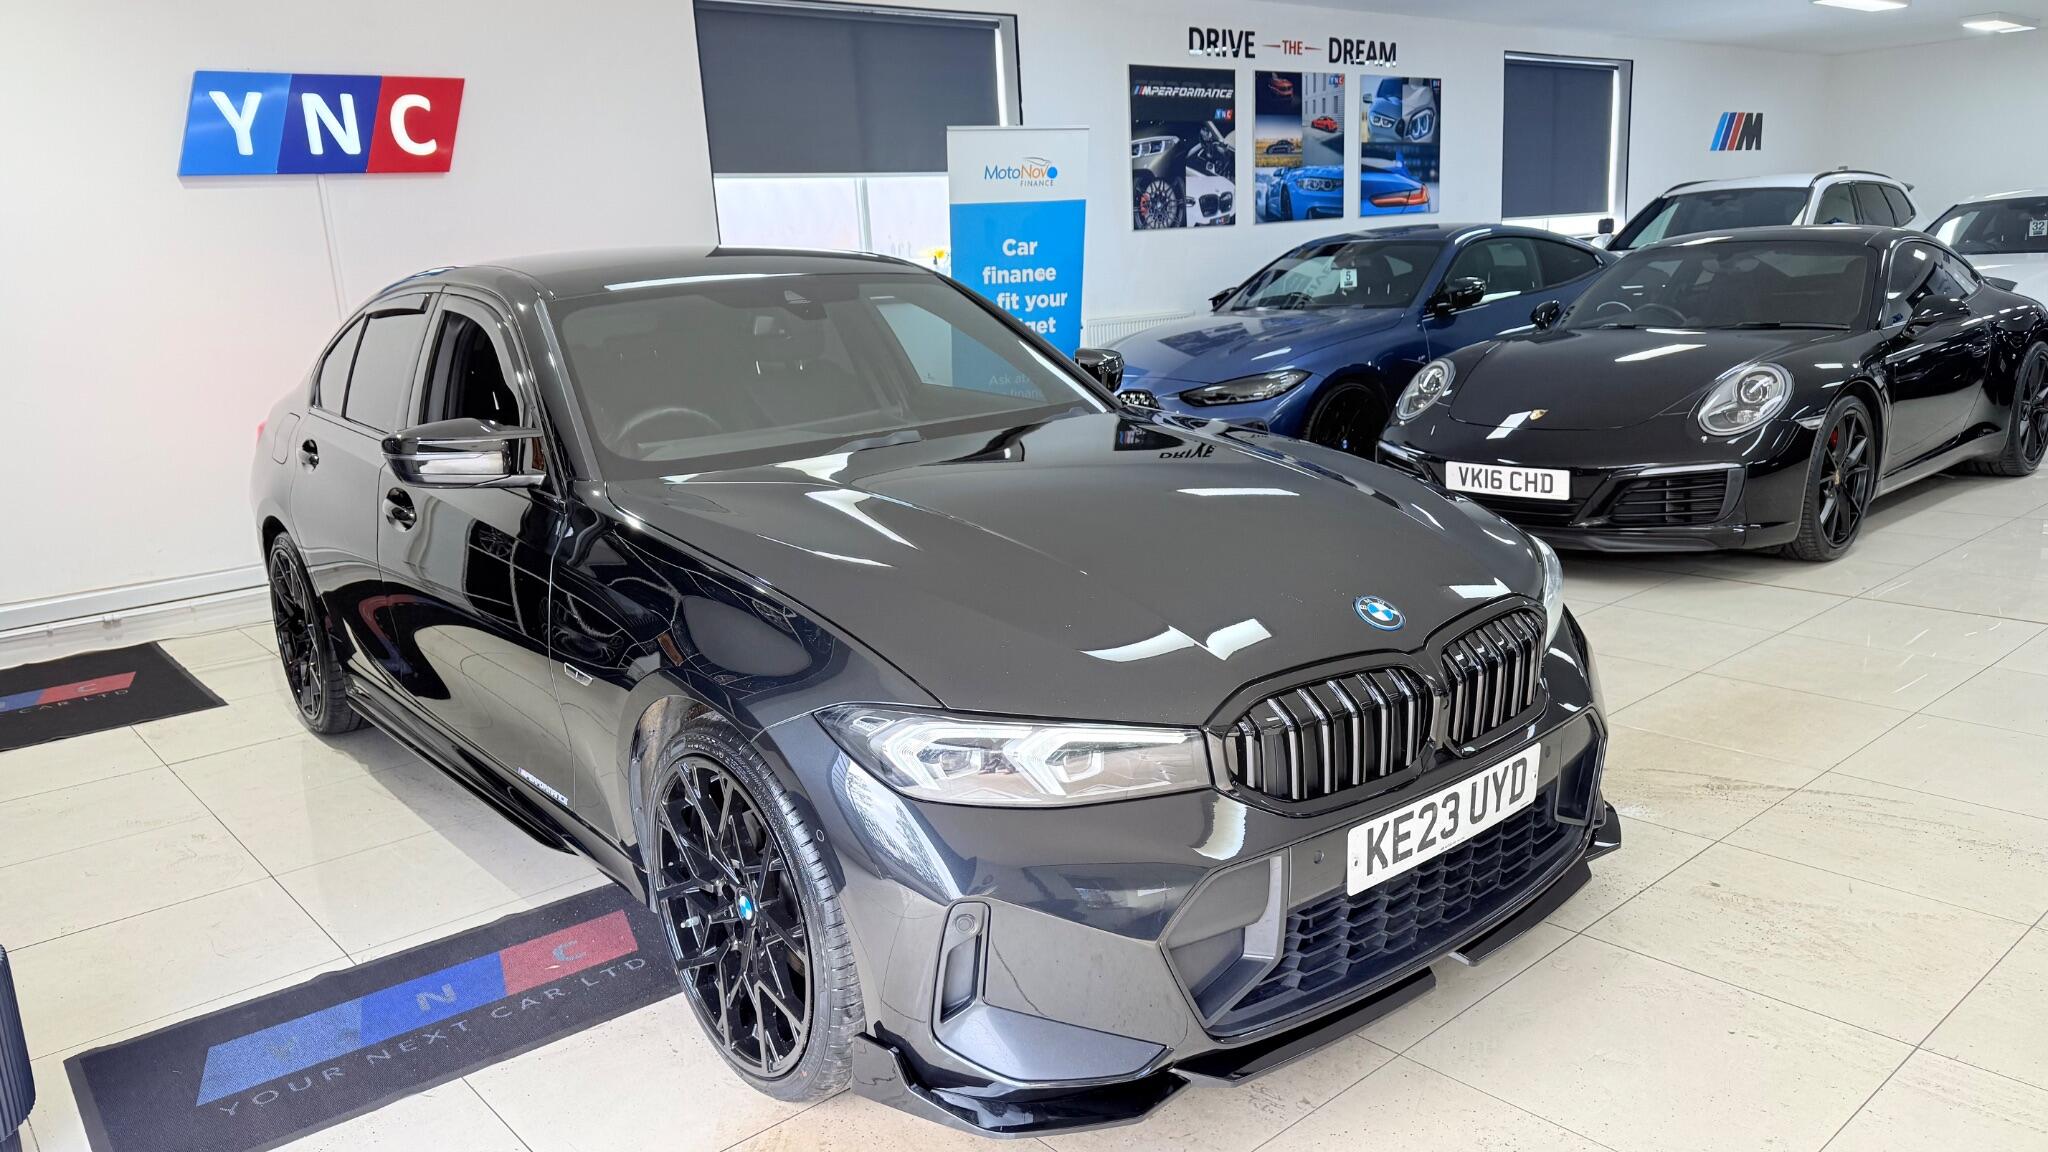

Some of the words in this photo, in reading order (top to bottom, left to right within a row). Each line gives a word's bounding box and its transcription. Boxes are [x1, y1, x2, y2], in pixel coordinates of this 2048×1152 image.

[1188, 26, 1256, 59] DRIVE
[1281, 40, 1304, 55] THE
[1328, 36, 1397, 68] DREAM
[208, 90, 438, 156] YNC
[984, 164, 1058, 180] MotoNovo
[2032, 221, 2045, 230] 32
[1002, 238, 1038, 256] Car
[982, 265, 1056, 285] finance
[1345, 270, 1351, 281] 5
[997, 292, 1020, 310] fit
[1024, 291, 1068, 312] your
[990, 374, 1011, 385] Ask
[1458, 466, 1502, 490] VK16
[1509, 470, 1554, 494] CHD
[83, 689, 129, 702] LTD
[1366, 791, 1460, 877] KE23
[1470, 757, 1528, 825] UYD
[219, 1067, 346, 1118] YOUR
[366, 1020, 470, 1066] NEXT
[491, 988, 566, 1019] CAR
[581, 958, 646, 988] LTD
